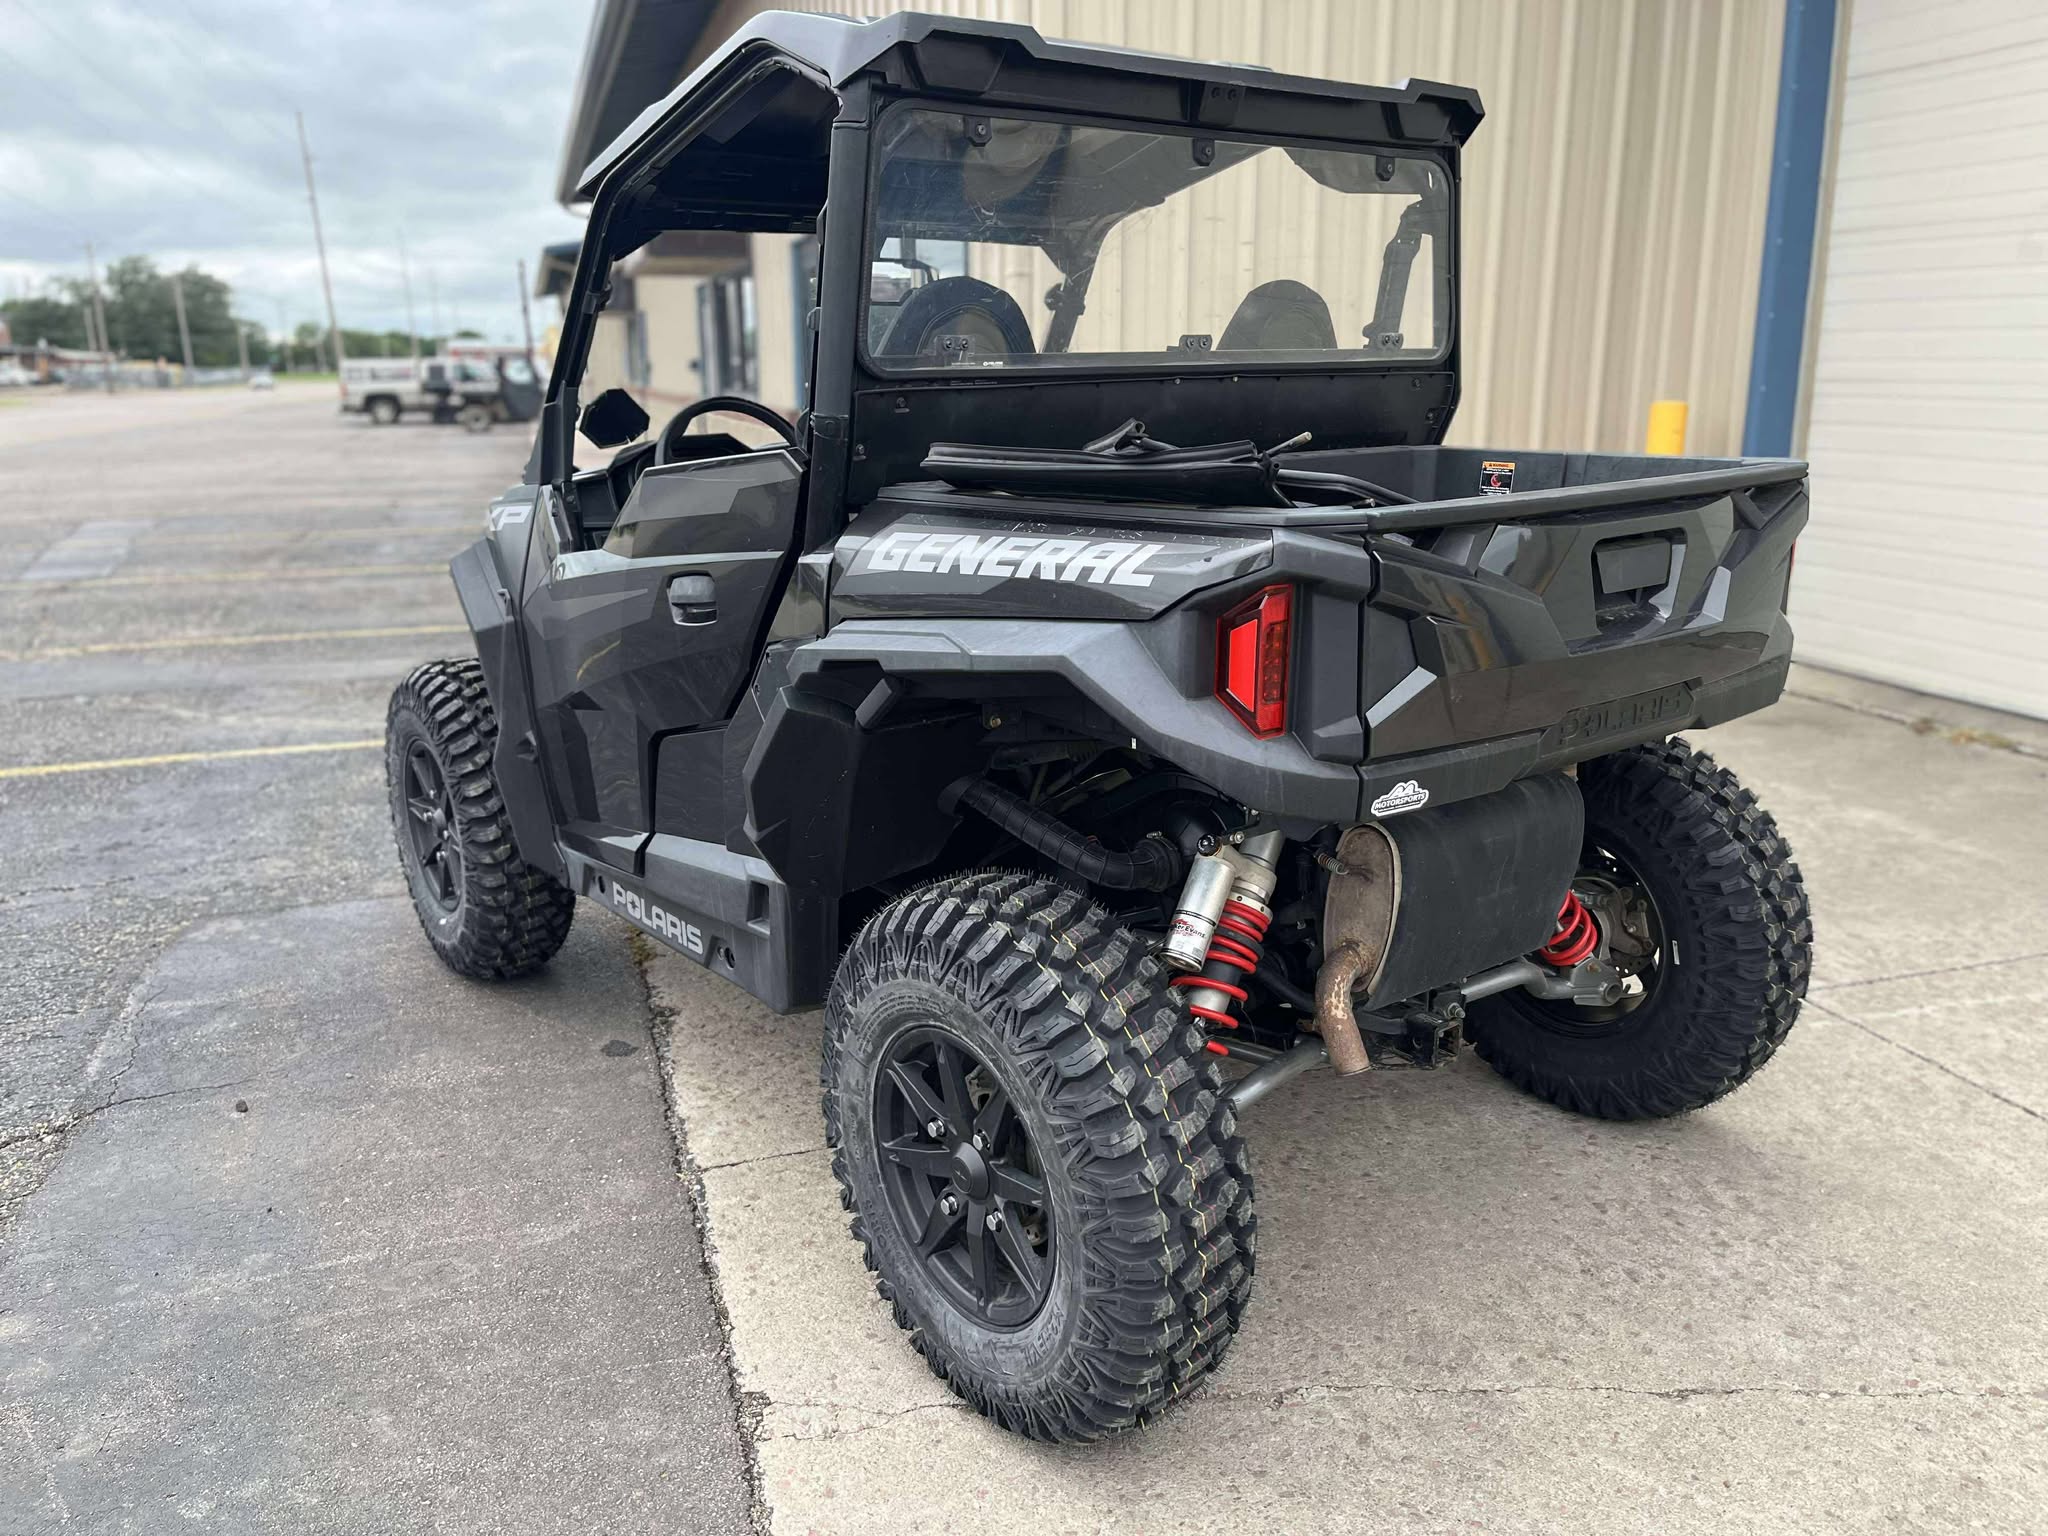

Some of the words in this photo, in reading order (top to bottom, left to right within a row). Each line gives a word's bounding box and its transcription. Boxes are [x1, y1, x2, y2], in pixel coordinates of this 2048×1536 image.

[867, 532, 1165, 587] GENERAL
[1557, 689, 1683, 745] POLARIS
[1374, 793, 1425, 809] MOTORSPORTS
[612, 881, 704, 955] POLARIS
[1184, 925, 1206, 938] Evans
